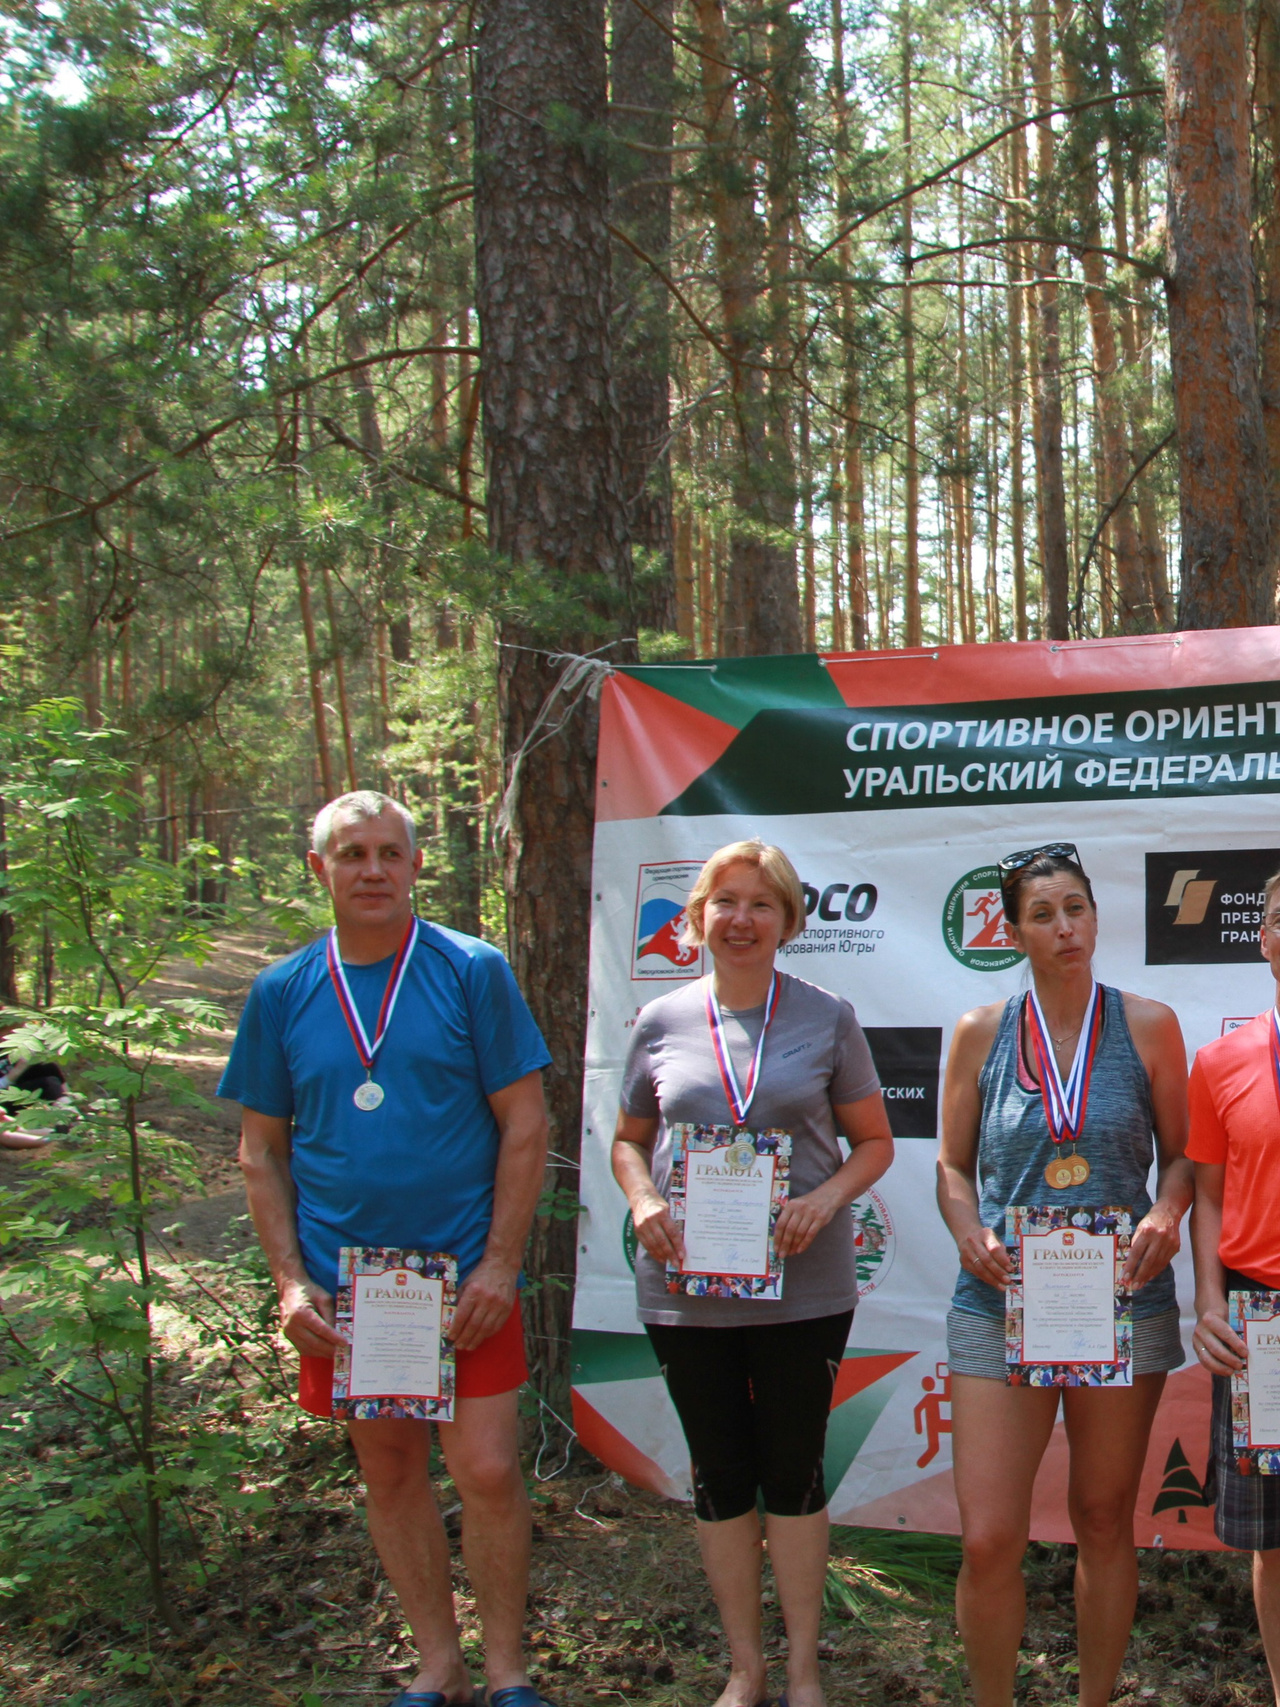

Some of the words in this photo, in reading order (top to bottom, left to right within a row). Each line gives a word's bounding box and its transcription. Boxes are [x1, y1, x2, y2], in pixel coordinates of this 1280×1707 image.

[846, 712, 1114, 752] СПОРТИВНОЕ
[843, 753, 1063, 798] УРАЛЬСКИЙ
[1220, 893, 1266, 906] ФОНД
[803, 928, 885, 940] спортивного
[1221, 931, 1261, 943] ГРАН
[778, 941, 836, 957] ирования
[838, 940, 876, 954] Югры
[1033, 1249, 1104, 1260] ГРАМОТА
[365, 1287, 433, 1301] ГРАМОТА
